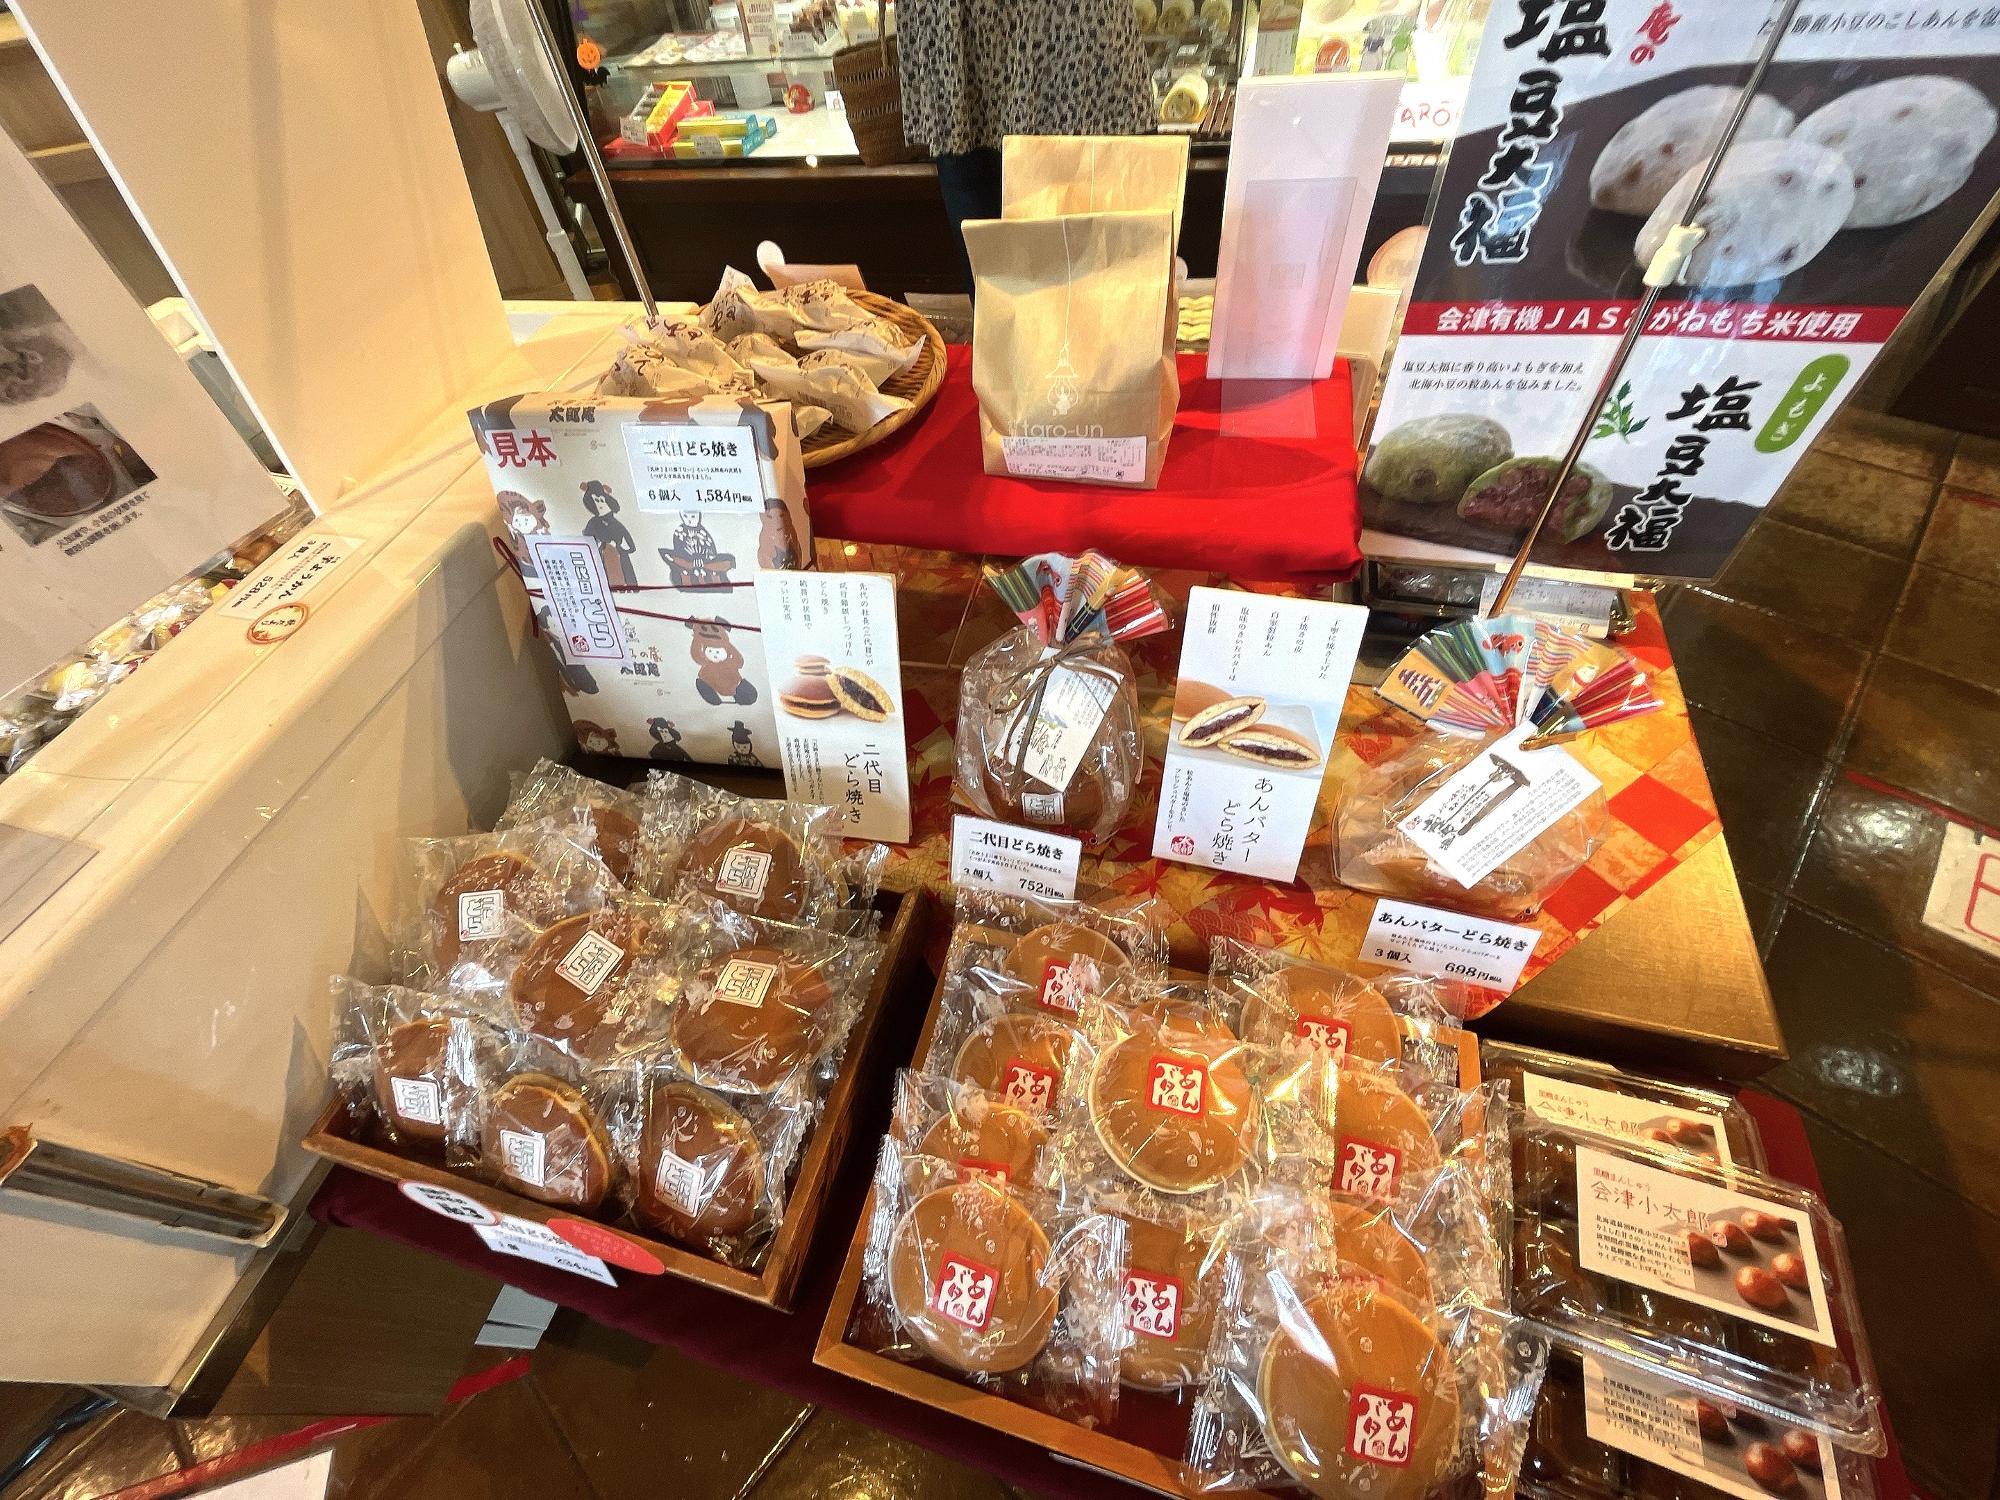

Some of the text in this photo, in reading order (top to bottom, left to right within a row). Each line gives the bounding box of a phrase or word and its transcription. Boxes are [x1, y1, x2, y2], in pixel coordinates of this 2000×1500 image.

[1770, 372, 1827, 441] よもぎ
[491, 429, 558, 468] 見本
[643, 440, 738, 457] 二代目どら焼き
[1605, 375, 1763, 552] 塩豆大福
[648, 489, 681, 502] 6個入
[844, 753, 864, 824] どら焼き
[863, 743, 883, 794] 二代目
[969, 831, 1064, 861] 二代目どら焼き
[1211, 799, 1241, 866] どら焼き
[1242, 778, 1273, 863] あんバター
[1375, 948, 1412, 964] 3個入
[1378, 912, 1529, 951] あんバターどら焼き
[1591, 1180, 1710, 1232] 会津小太郎
